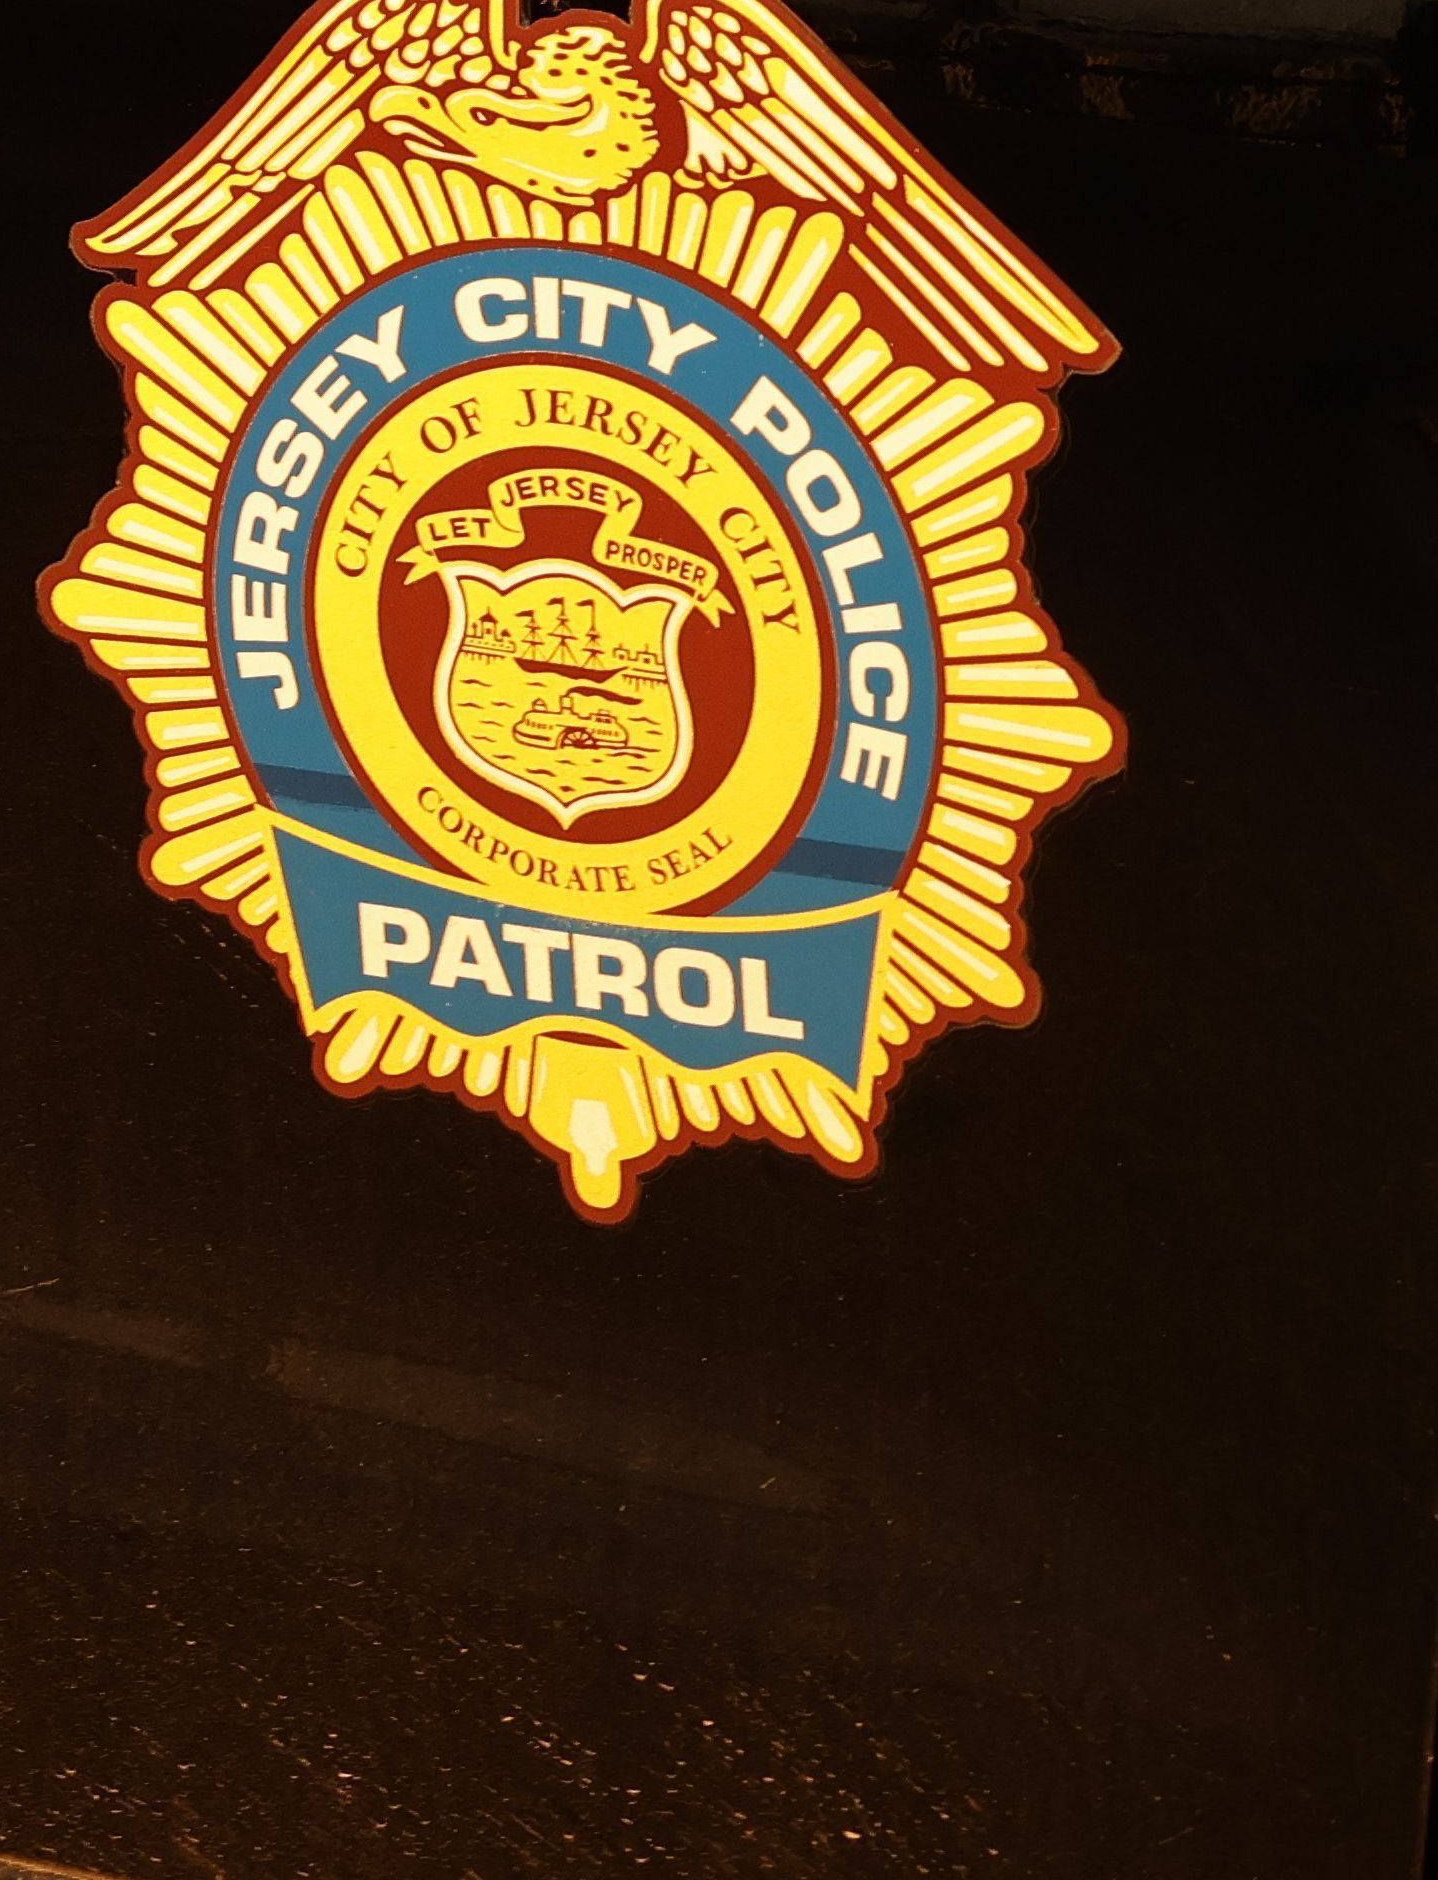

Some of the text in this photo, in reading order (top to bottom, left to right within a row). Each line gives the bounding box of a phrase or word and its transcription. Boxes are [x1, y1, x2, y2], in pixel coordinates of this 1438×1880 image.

[232, 275, 912, 802] JERSEY CITY POLICE
[334, 387, 801, 635] CITY OF JERSEY CITY
[427, 475, 710, 587] LET JERSEY PROSPER
[416, 784, 733, 894] CORPORATE SEAL
[357, 901, 806, 1041] PATROL
